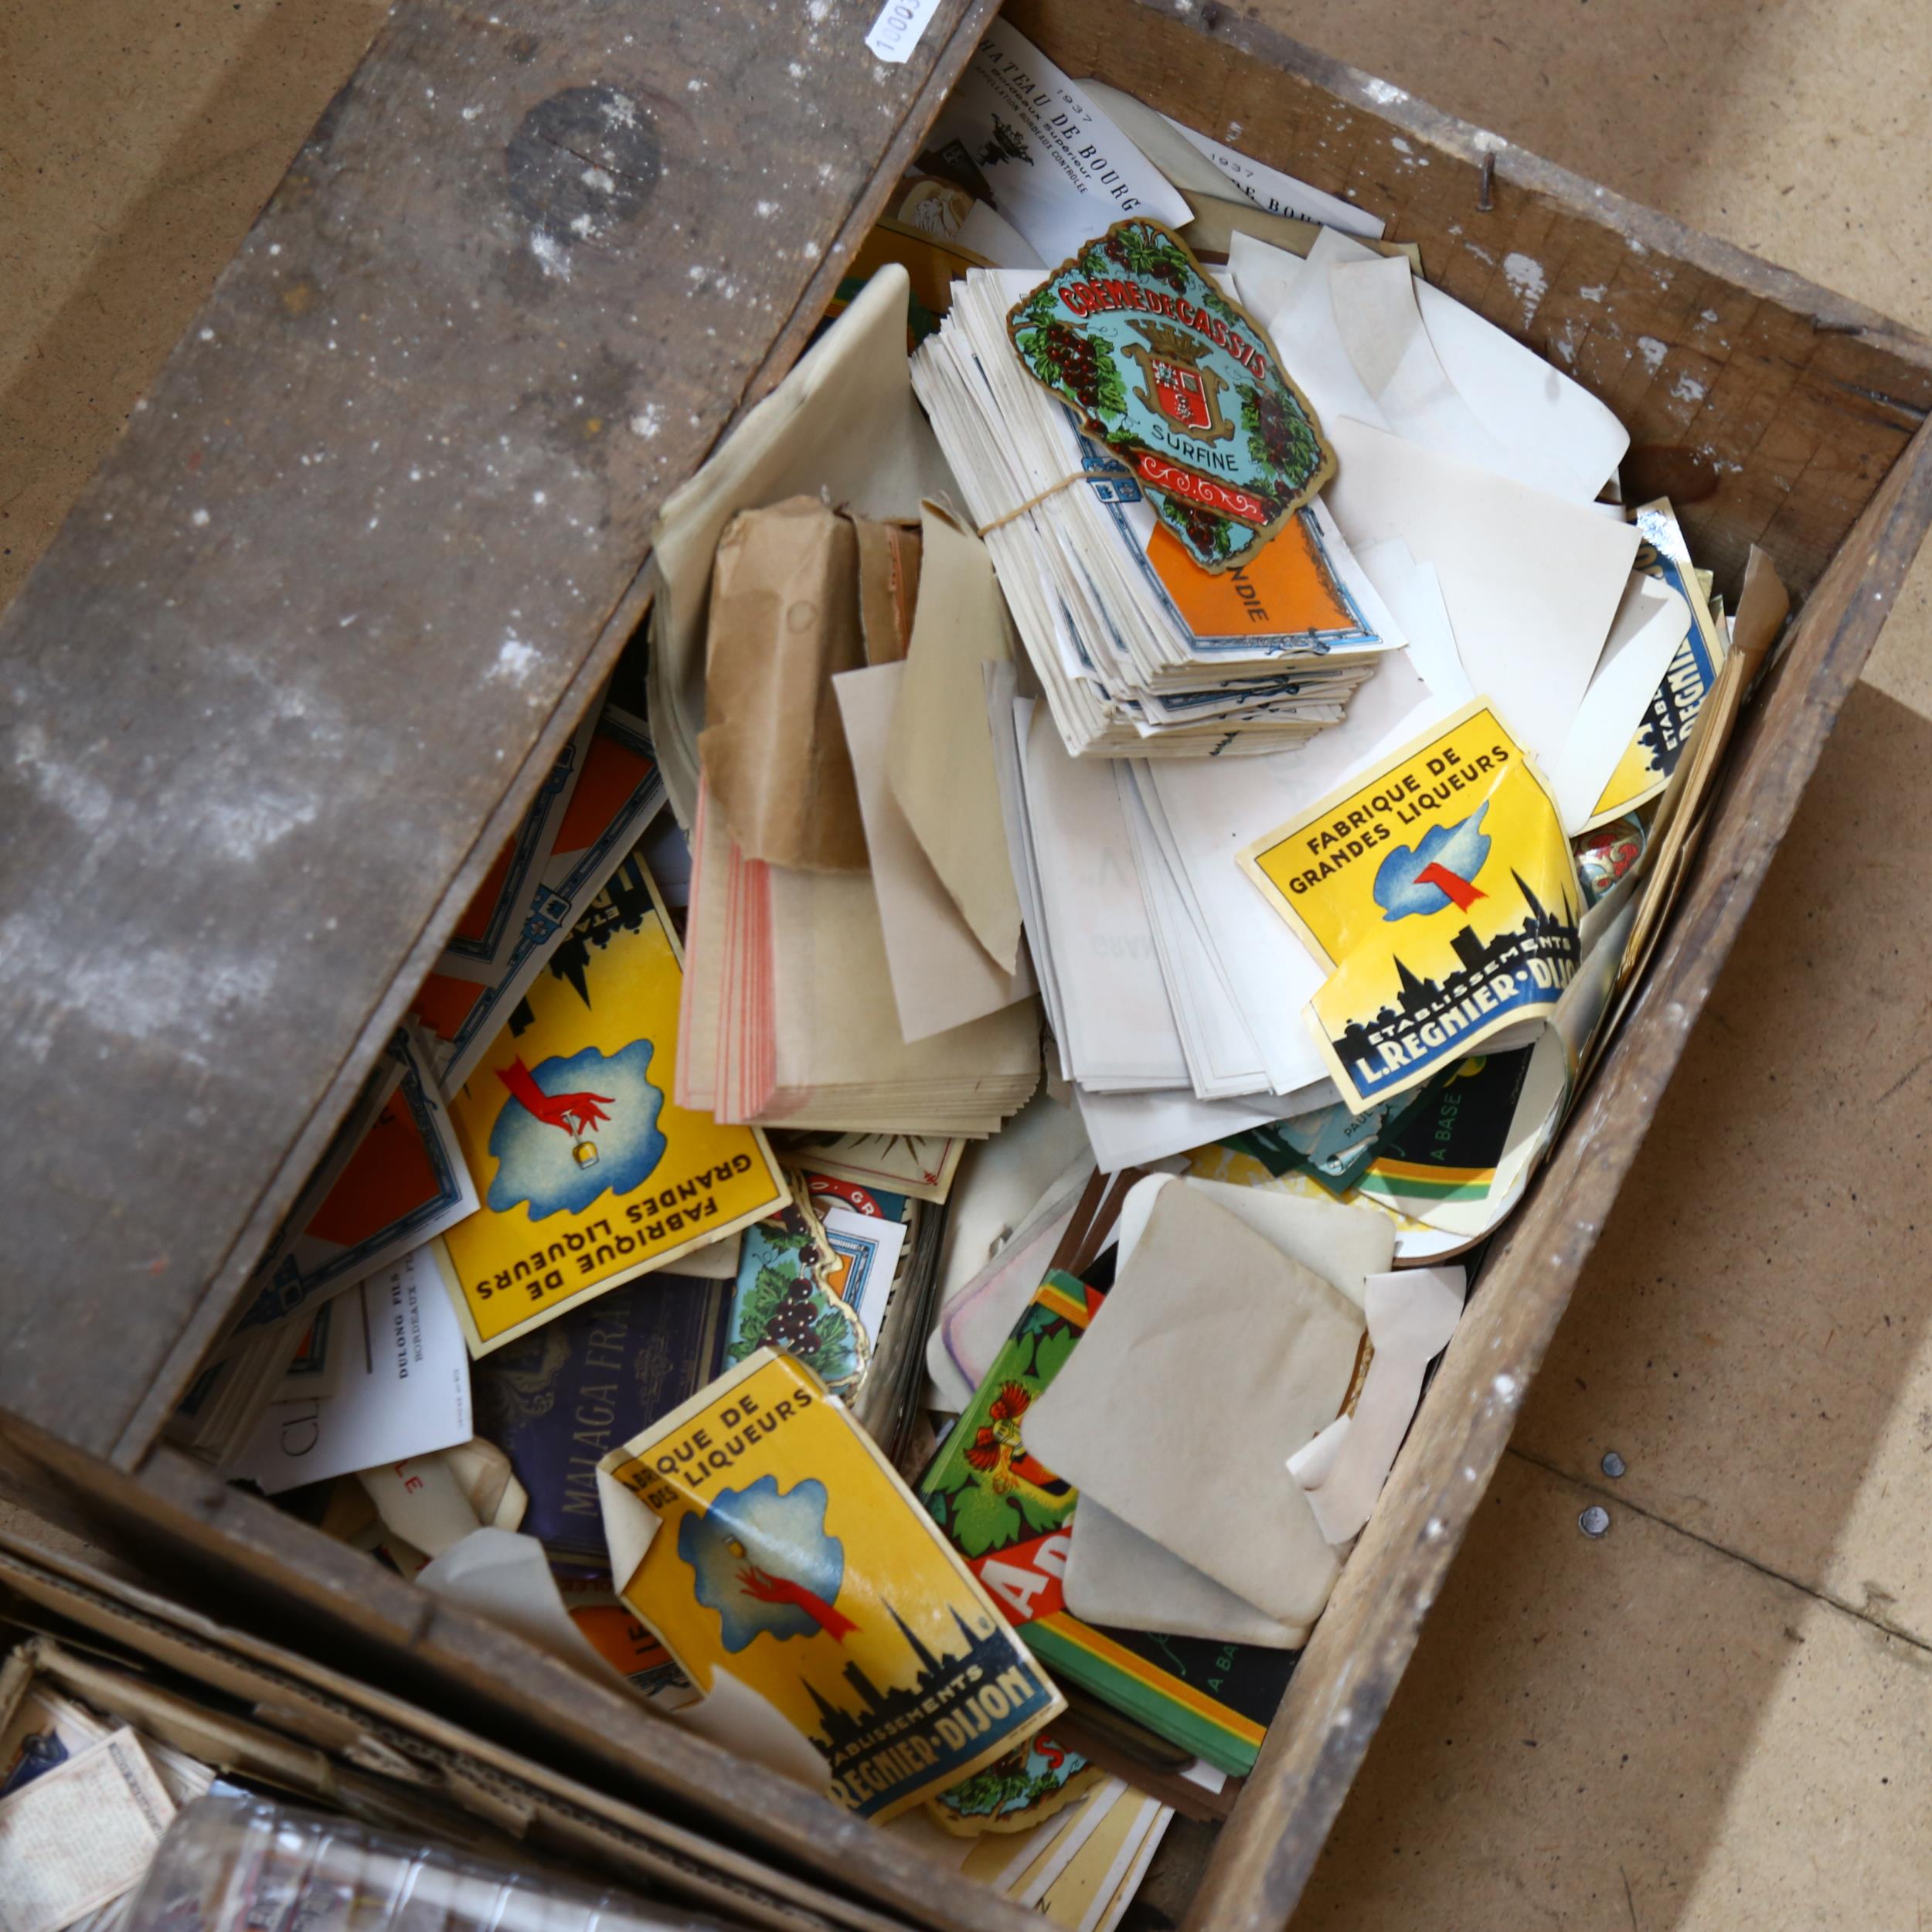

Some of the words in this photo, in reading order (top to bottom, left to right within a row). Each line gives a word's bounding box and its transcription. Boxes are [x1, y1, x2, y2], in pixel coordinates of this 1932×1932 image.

[975, 66, 1019, 111] APPELLATION
[1020, 113, 1053, 151] BORDEAUX
[990, 68, 1042, 121] Bordeaux
[1043, 123, 1092, 179] Supérieur
[1056, 89, 1092, 122] 1937
[1050, 113, 1080, 139] DE
[1079, 145, 1141, 211] BOURG
[1212, 154, 1253, 178] 1937
[1144, 288, 1176, 320] DE
[1175, 297, 1267, 380] CASSIS
[1151, 424, 1239, 471] SURFINE
[1290, 824, 1390, 893] GRANDES
[1396, 745, 1509, 825] LIQUEURS
[1307, 774, 1420, 855] FABRIQUE
[1427, 747, 1461, 777] DE
[1368, 937, 1570, 1045] ETABLISSEMENTS
[1430, 1148, 1447, 1161] A
[1434, 1094, 1461, 1141] BASE
[626, 1153, 753, 1223] GRANDES
[476, 1219, 612, 1301] LIQUEURS
[580, 1198, 719, 1274] FABRIQUE
[390, 1274, 403, 1306] FILS
[526, 1270, 564, 1301] DE
[394, 1315, 409, 1379] DULONG
[407, 1286, 423, 1362] BORDEAUX
[684, 1388, 813, 1488] LIQUEURS
[719, 1394, 759, 1429] DE
[562, 1385, 619, 1517] MALAGA
[935, 1665, 1036, 1751] DIJON
